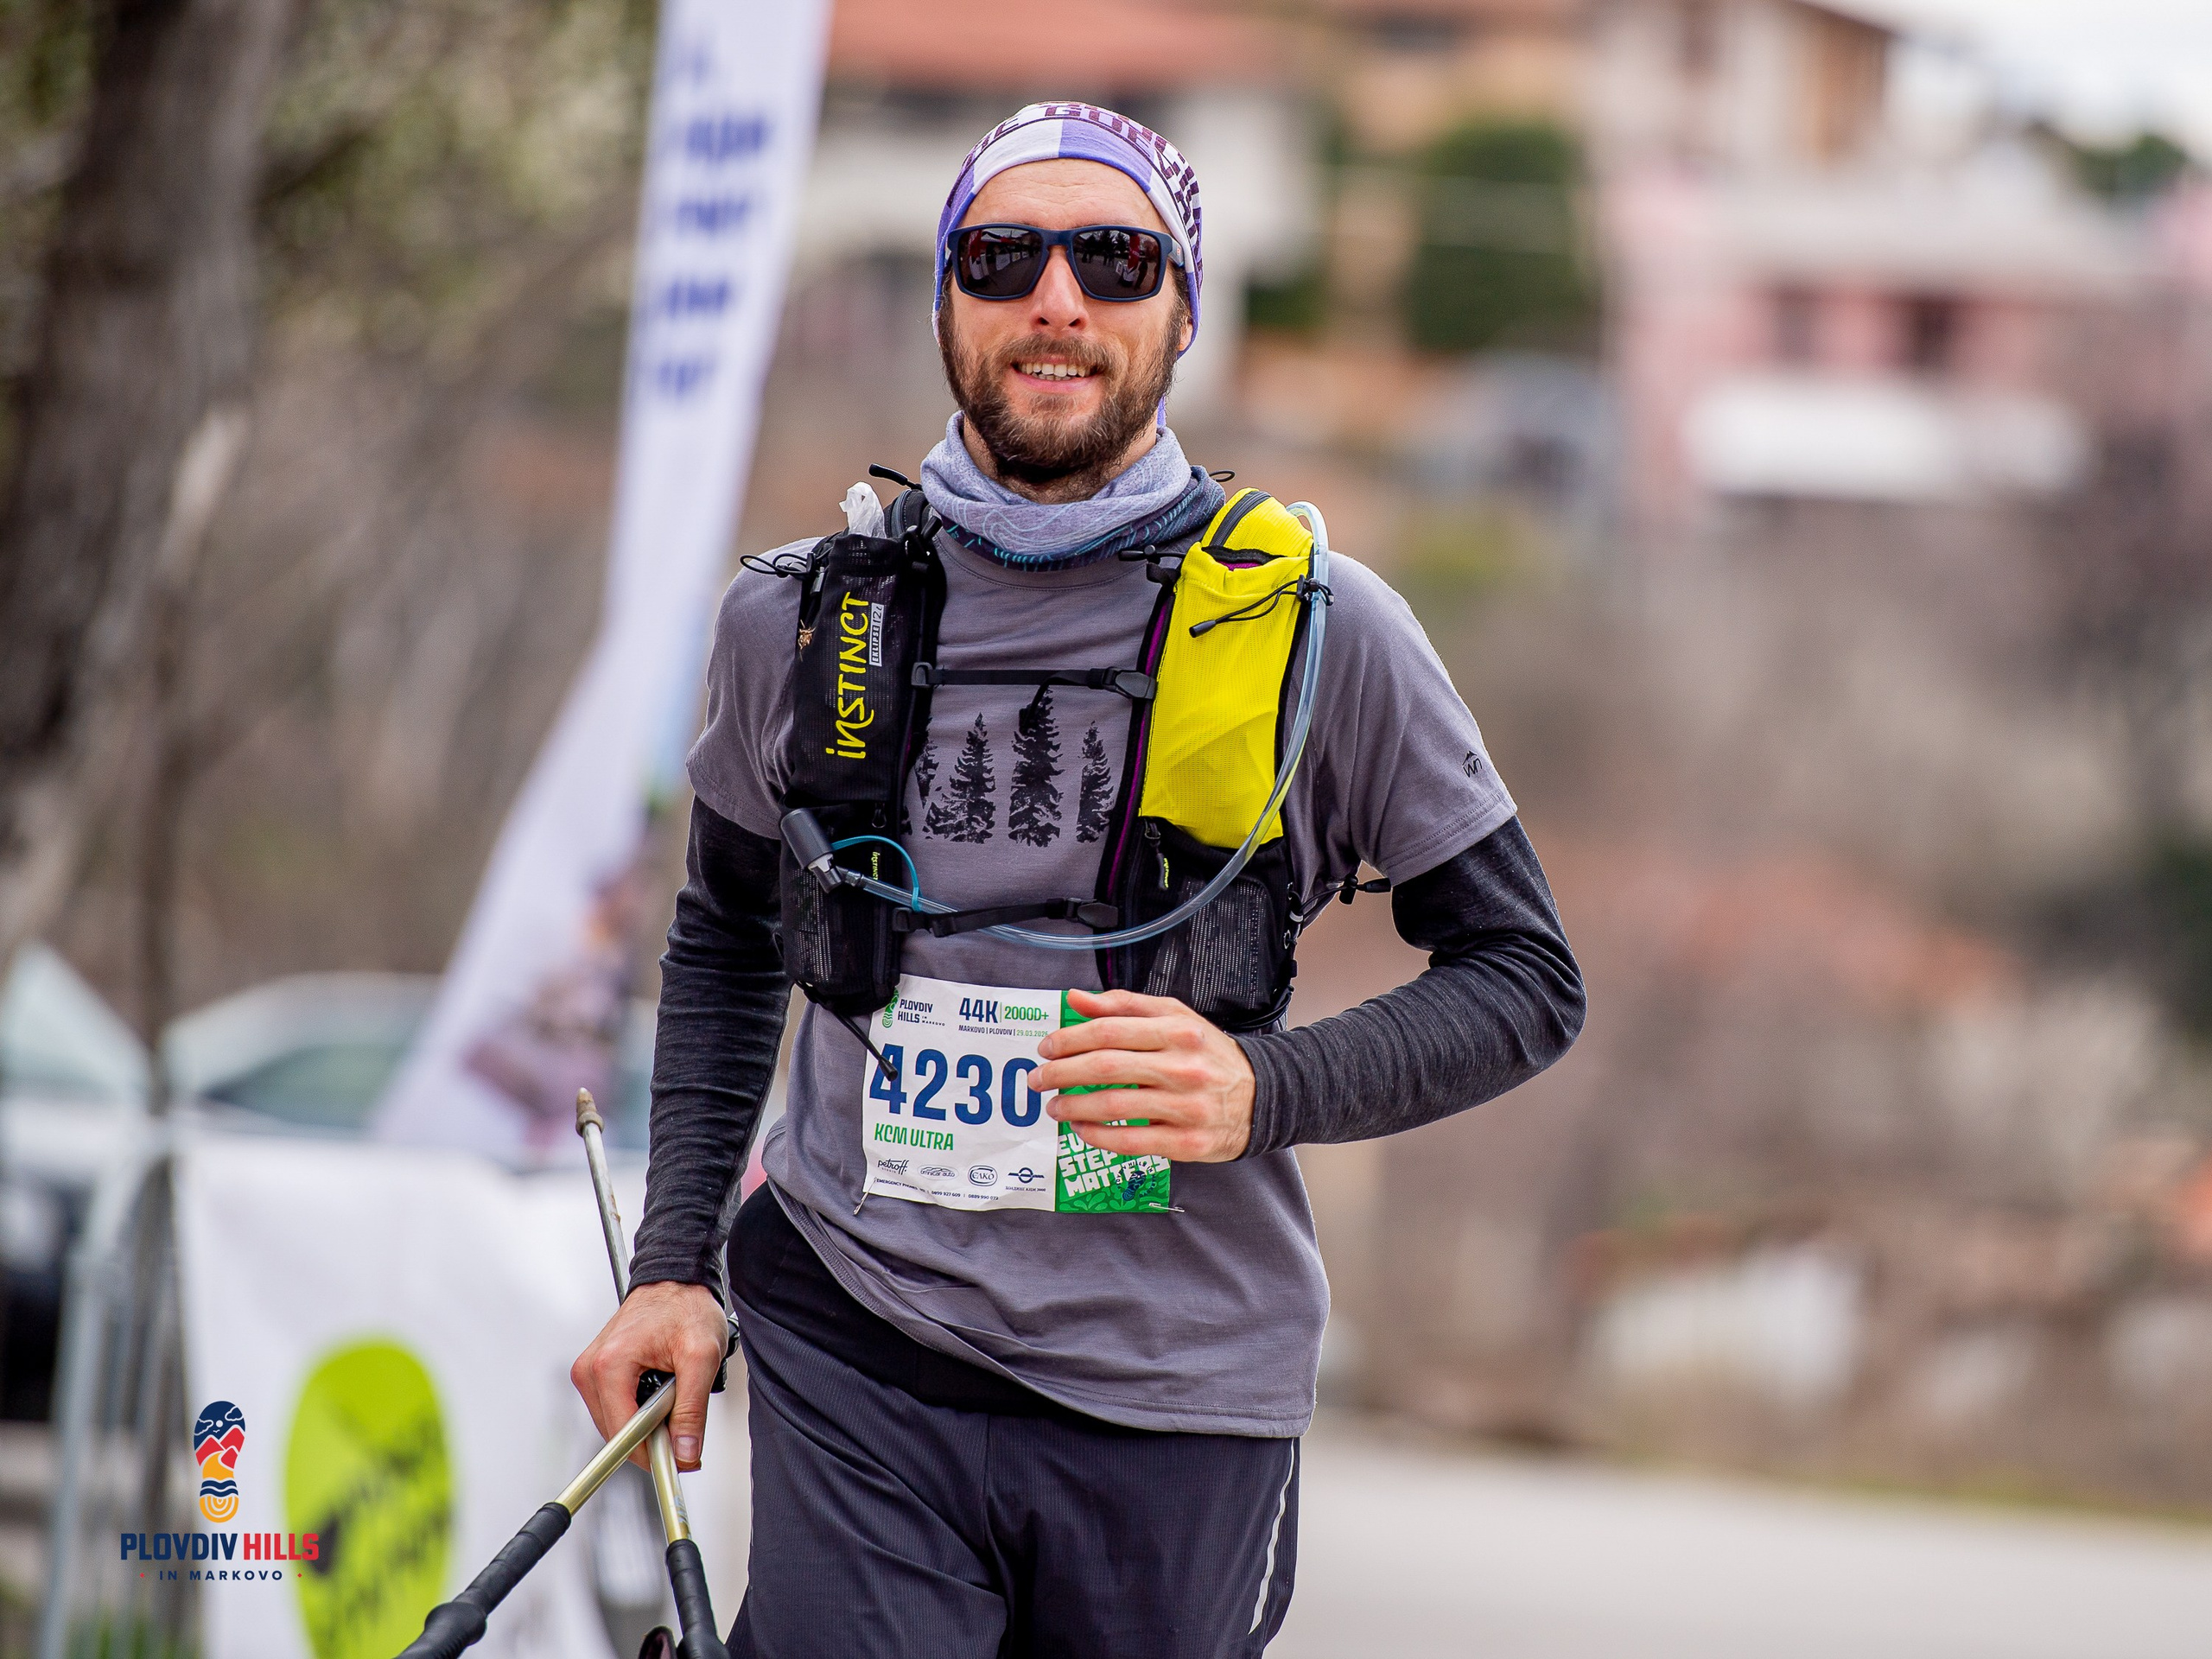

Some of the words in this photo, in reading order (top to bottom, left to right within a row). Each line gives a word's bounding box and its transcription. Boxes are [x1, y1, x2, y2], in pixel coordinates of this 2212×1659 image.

[897, 1010, 920, 1025] HILLS
[899, 998, 933, 1014] PLOVDIV
[958, 997, 998, 1024] 44K
[1004, 1006, 1049, 1021] 2000D+
[958, 1025, 985, 1034] MARKOVO
[989, 1027, 1012, 1036] PLOVDIV
[869, 1042, 1041, 1128] 4230
[874, 1122, 907, 1146] KCM
[910, 1128, 954, 1151] ULTRA
[1058, 1148, 1117, 1178] STEP
